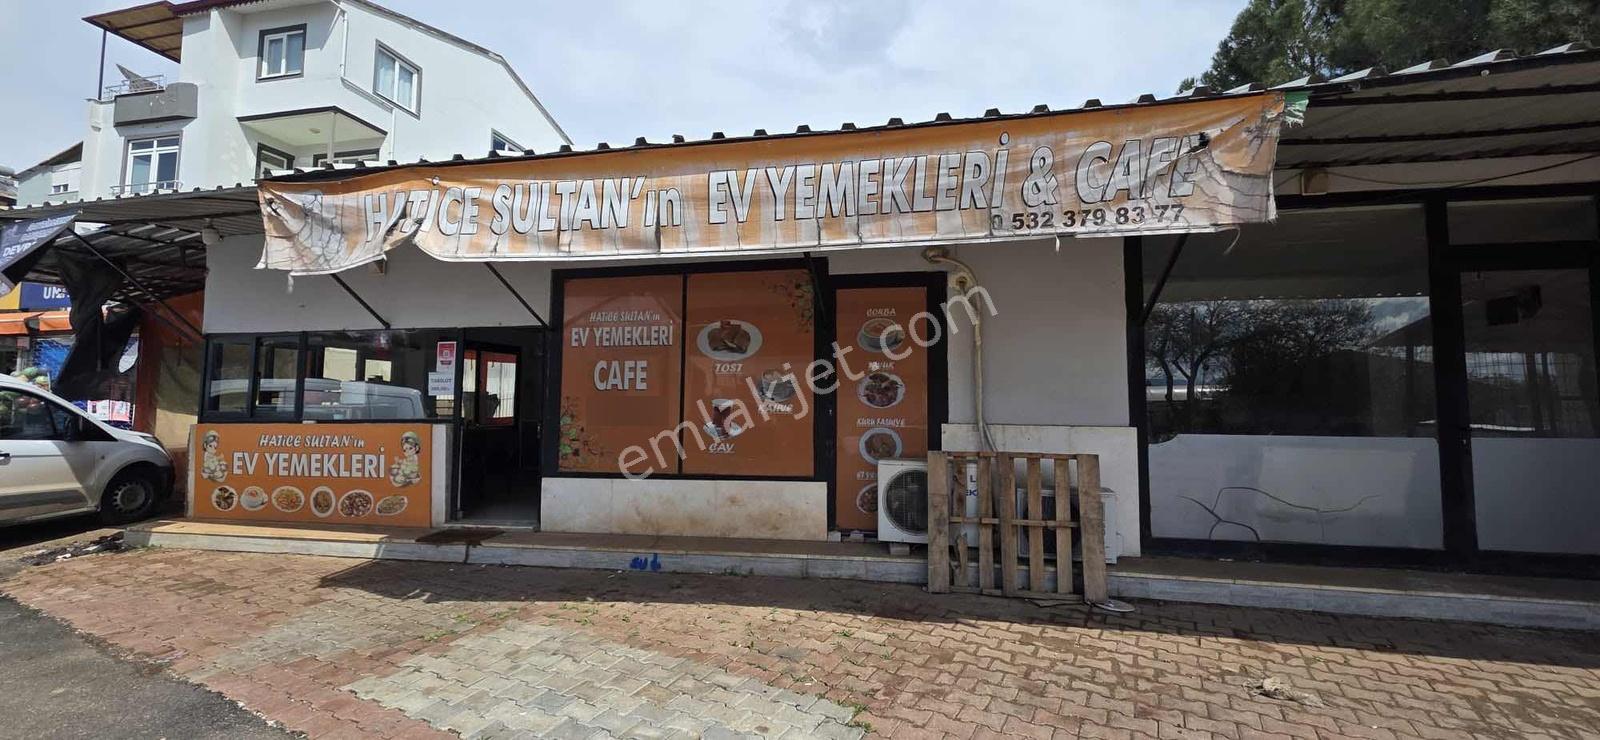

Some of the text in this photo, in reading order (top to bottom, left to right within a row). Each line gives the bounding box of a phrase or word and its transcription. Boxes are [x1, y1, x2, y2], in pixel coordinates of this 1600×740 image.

[708, 167, 758, 225] EV
[765, 131, 1010, 222] YEMEKLERİ
[1022, 146, 1058, 208] &
[1075, 135, 1201, 204] CAFE
[992, 204, 1185, 231] 0 532 379 83 77
[571, 319, 673, 348] EV YEMEKLERİ
[593, 360, 648, 391] CAFE
[714, 362, 744, 375] TOST
[232, 446, 386, 478] EV YEMEKLERİ
